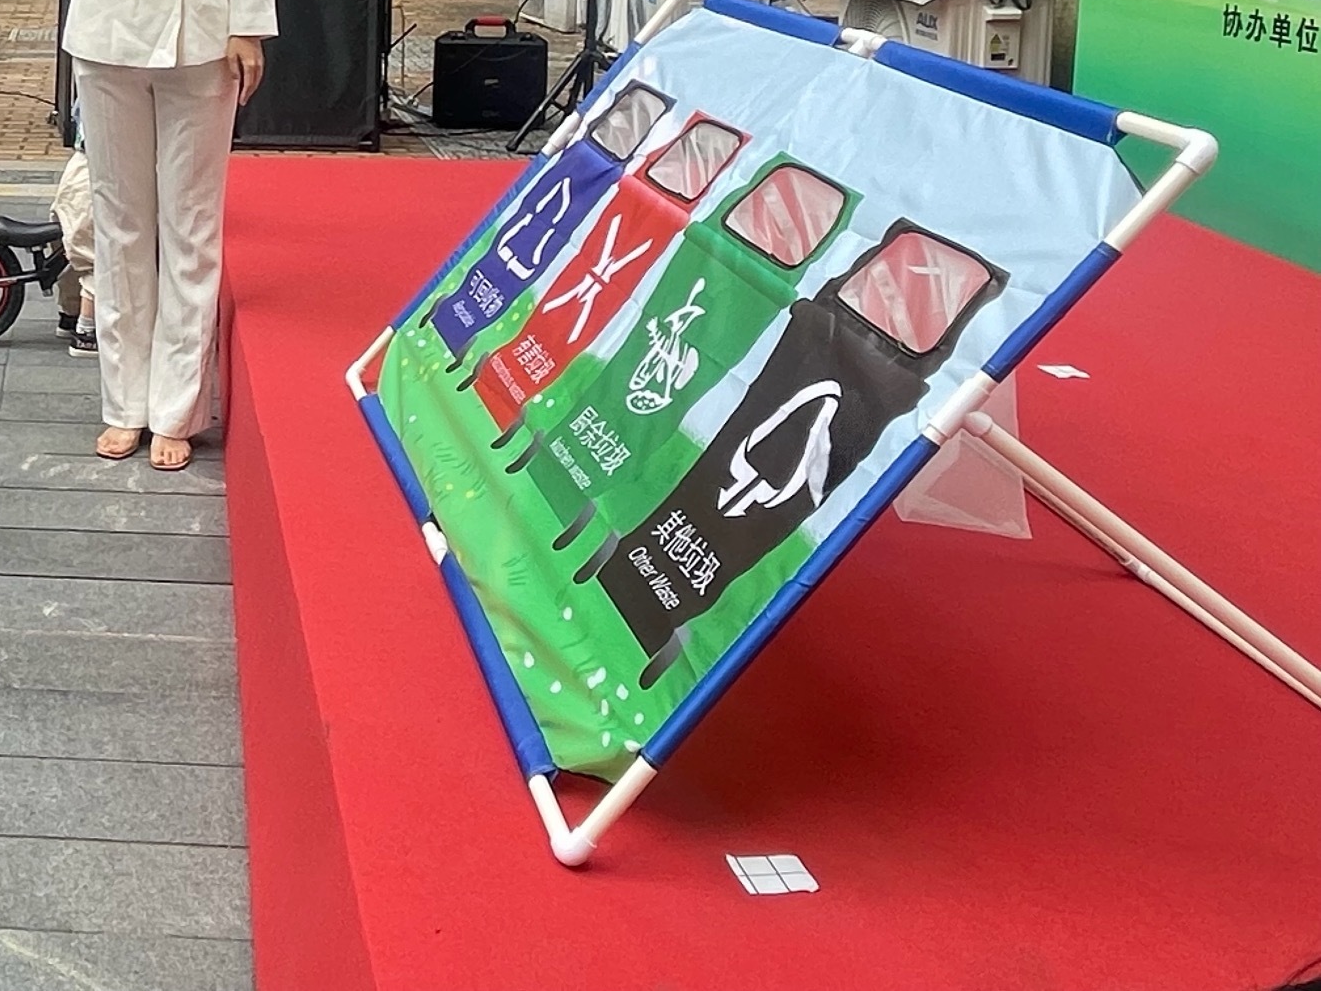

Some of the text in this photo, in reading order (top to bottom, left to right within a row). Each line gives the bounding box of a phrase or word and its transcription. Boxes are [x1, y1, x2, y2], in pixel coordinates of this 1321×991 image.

[1222, 3, 1320, 53] 协办单位
[512, 334, 556, 384] 有害垃圾
[569, 405, 631, 476] 厨余垃圾
[628, 546, 680, 609] Other Waste
[651, 510, 721, 596] 其他垃圾
